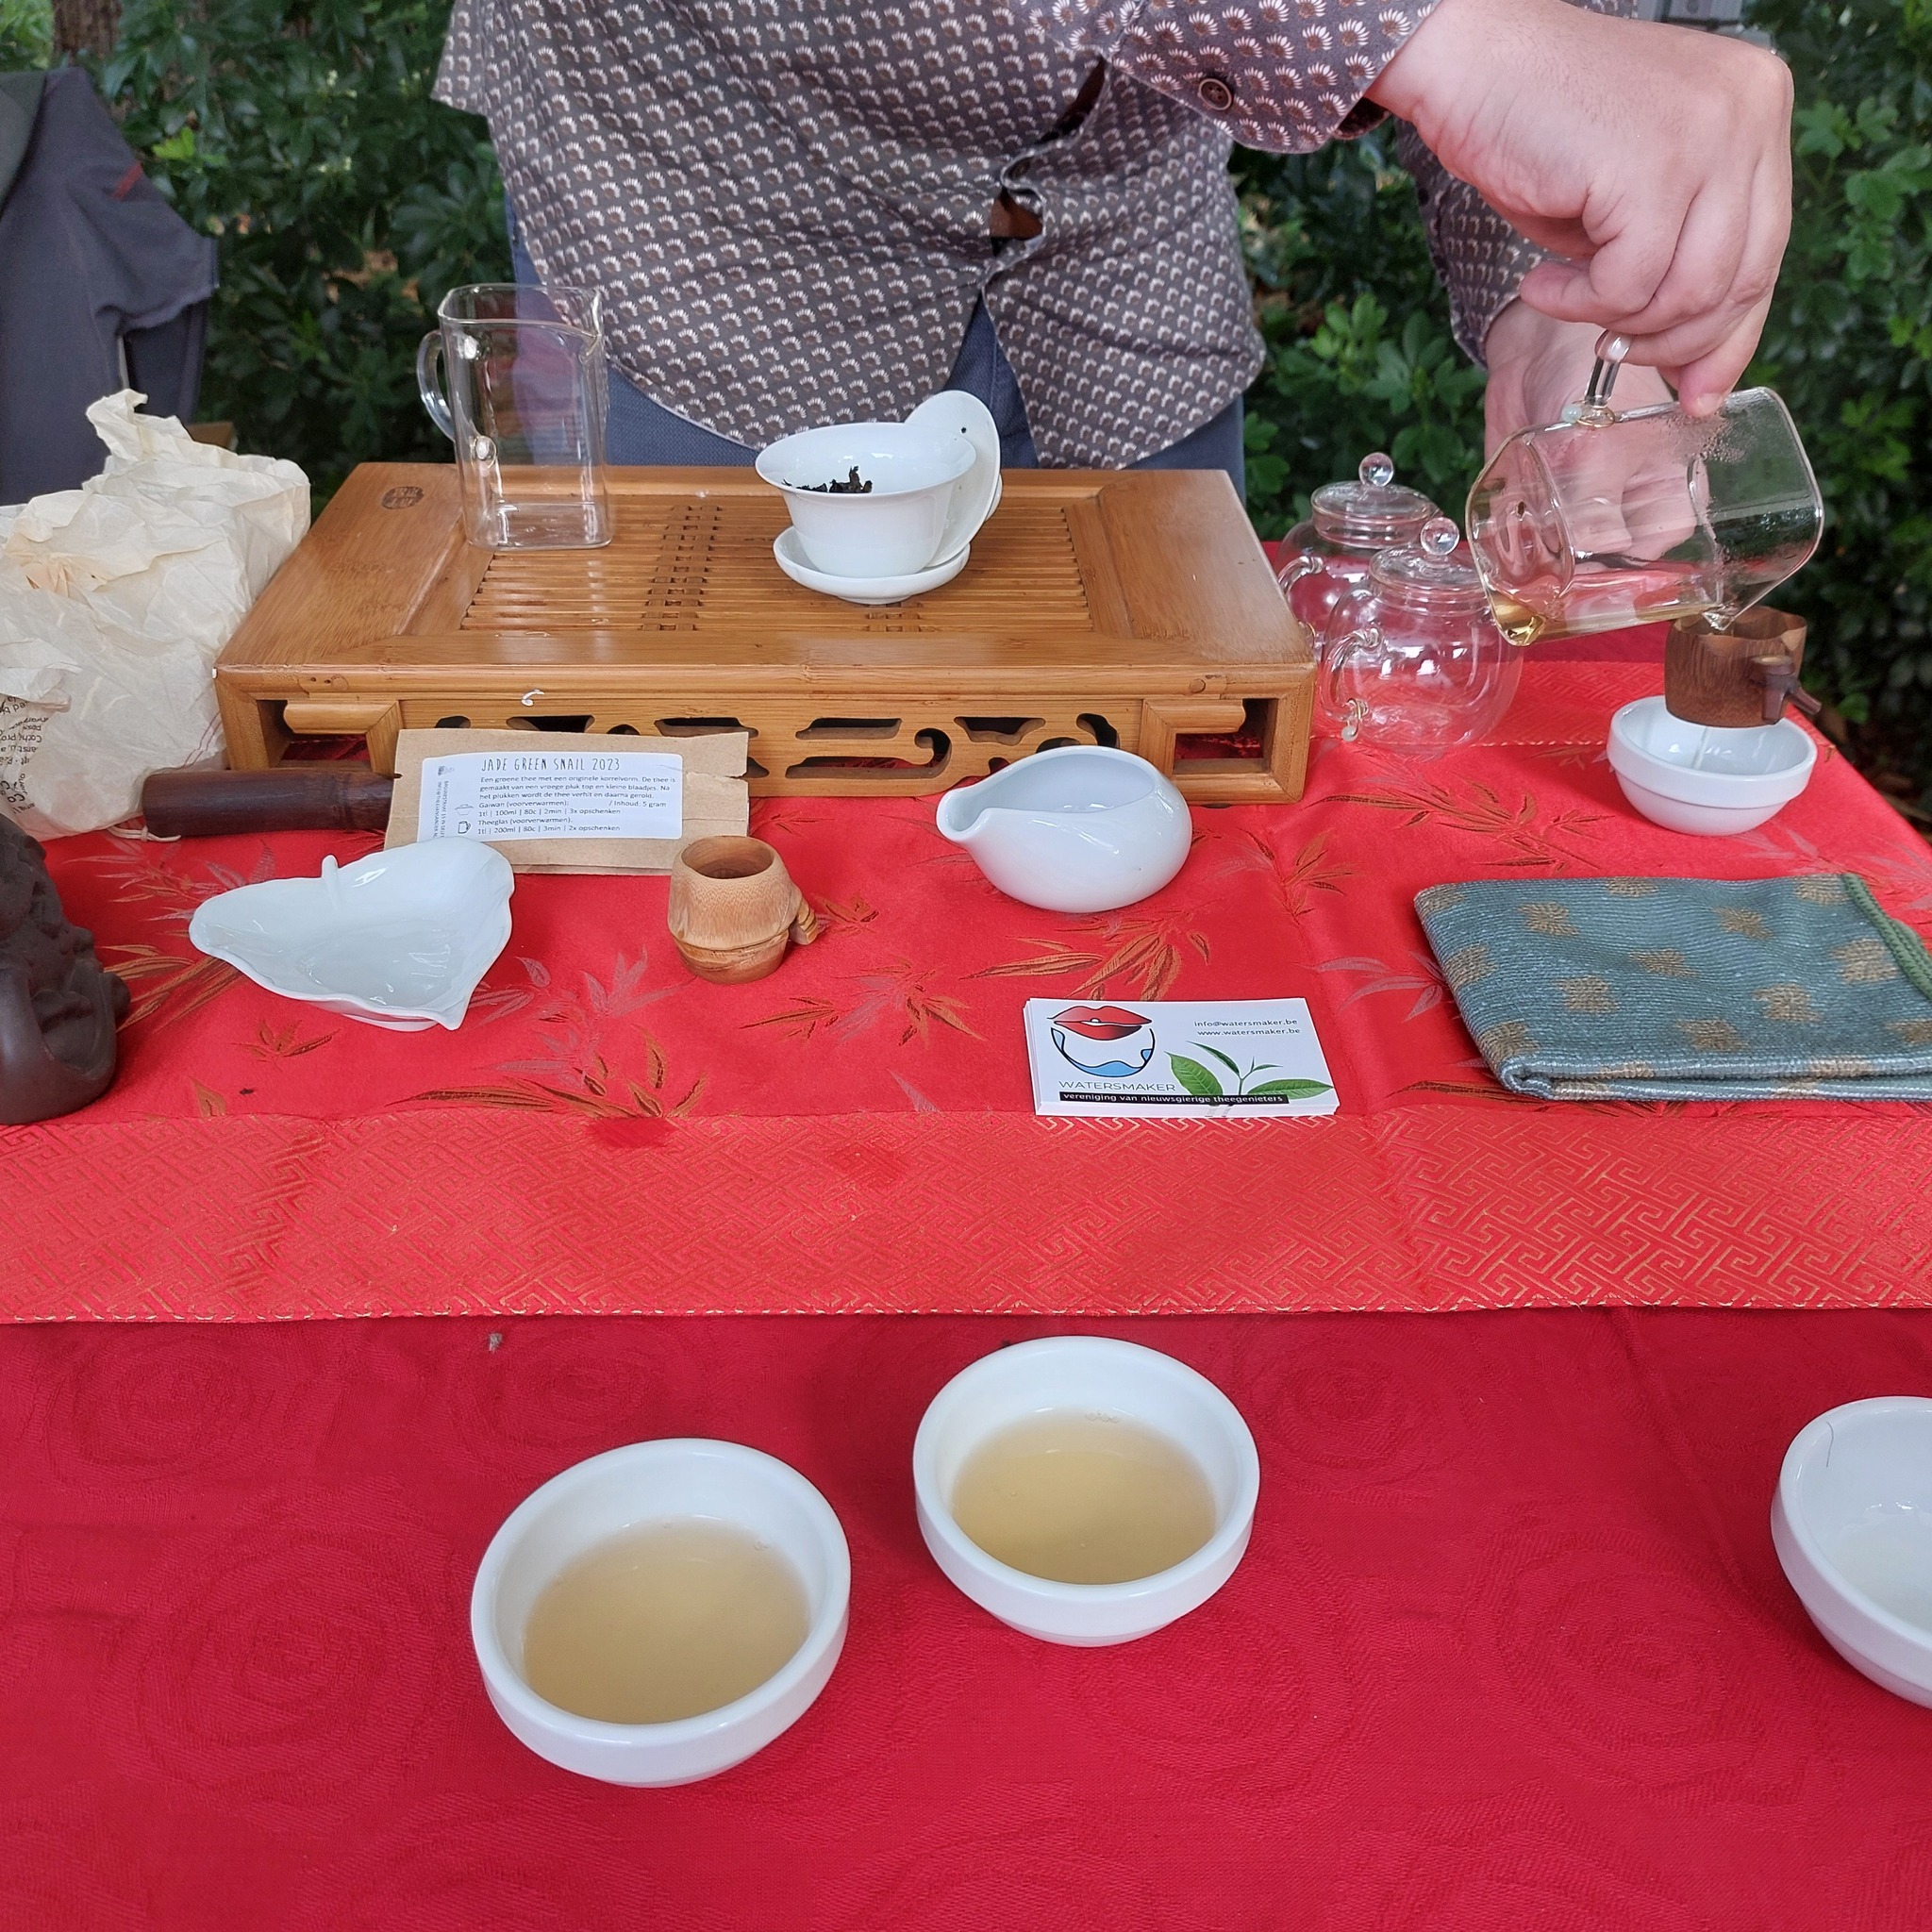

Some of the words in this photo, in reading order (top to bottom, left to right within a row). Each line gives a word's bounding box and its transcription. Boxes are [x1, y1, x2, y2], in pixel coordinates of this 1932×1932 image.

[481, 758, 508, 772] JADE
[514, 757, 547, 771] GREEN
[553, 758, 585, 771] SNAIL
[591, 758, 620, 771] 2023
[479, 784, 510, 792] gemaakt
[627, 784, 658, 792] blaadjes.
[1193, 1019, 1298, 1027] info@watersmaker.be
[1058, 1080, 1176, 1091] WATERSMAKER
[1063, 1092, 1117, 1102] vereniging
[1141, 1094, 1210, 1104] nieuwsgierige
[1213, 1095, 1283, 1104] theegenieters
